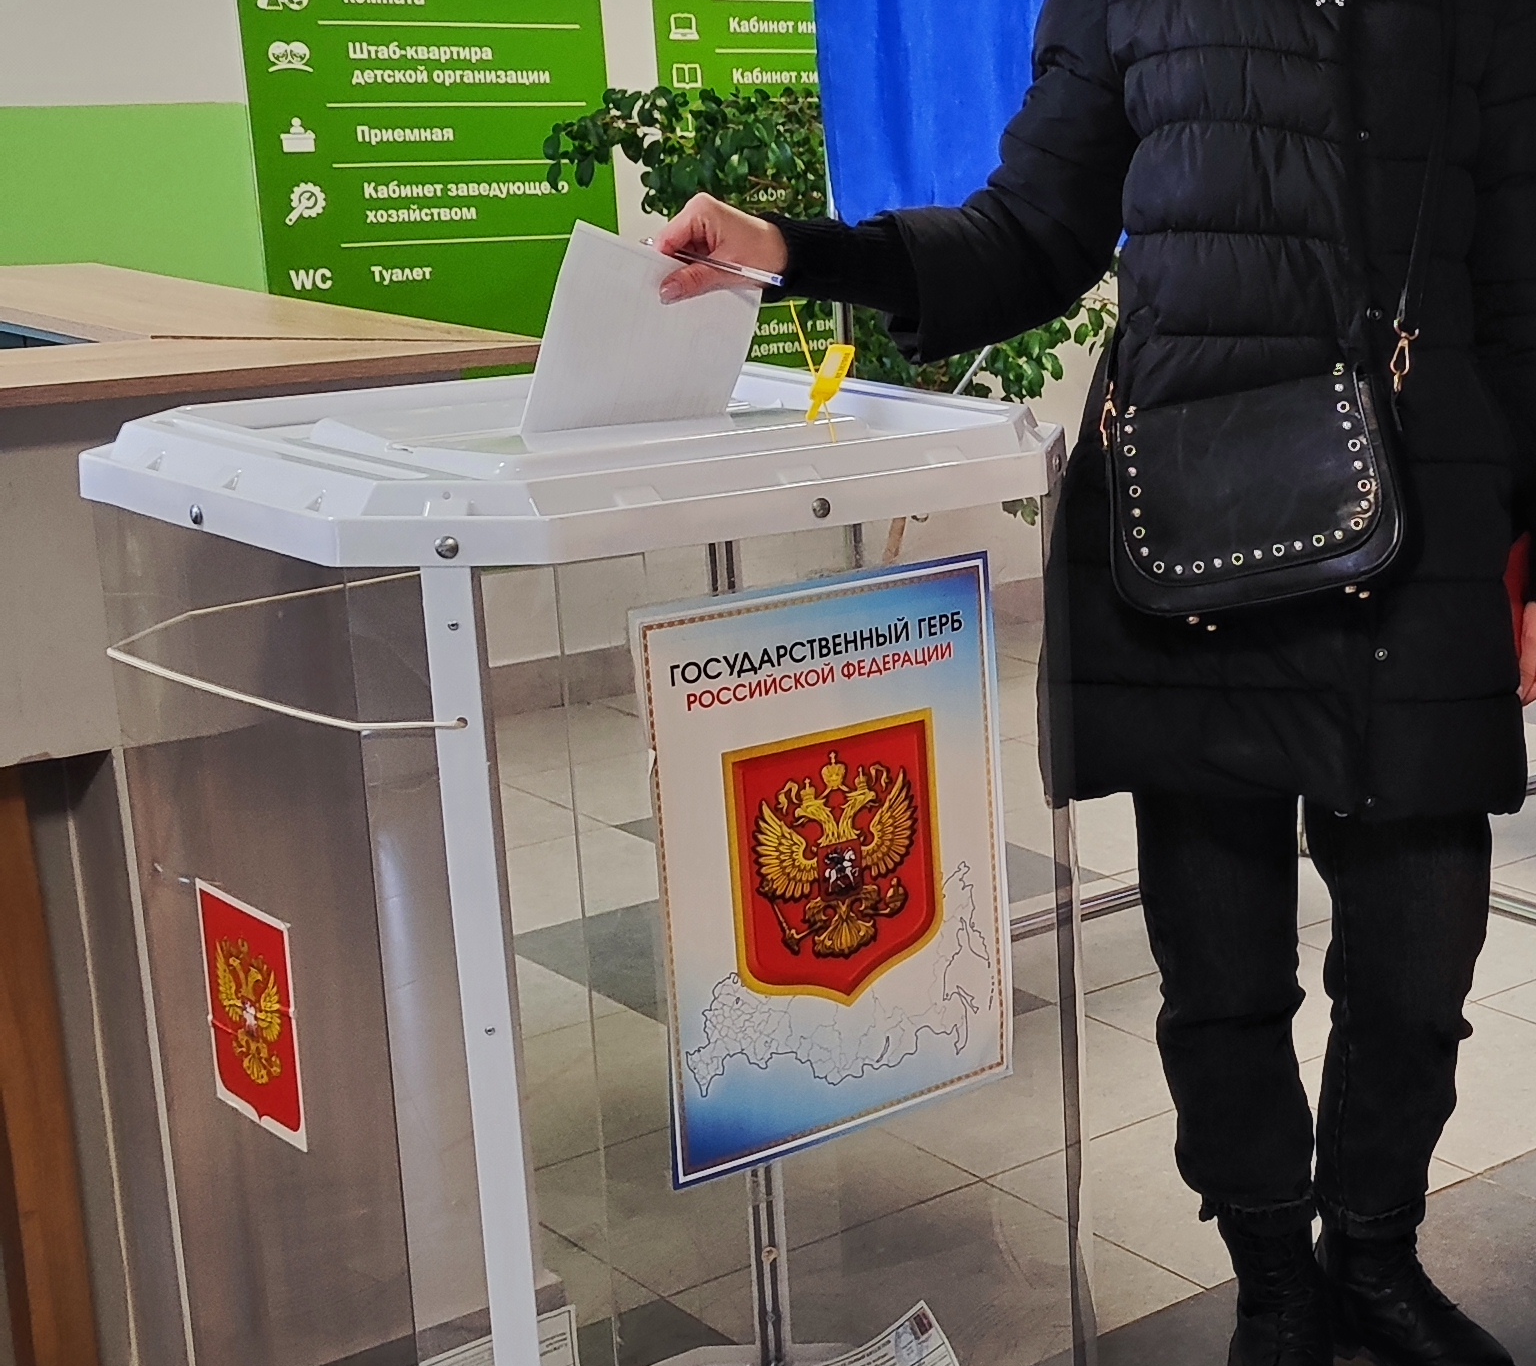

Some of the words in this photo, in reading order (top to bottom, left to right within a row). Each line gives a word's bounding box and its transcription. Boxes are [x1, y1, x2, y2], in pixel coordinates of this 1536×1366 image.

[729, 17, 794, 34] Кабинет
[348, 41, 492, 63] Штаб-квартира
[352, 66, 428, 85] детской
[433, 68, 551, 87] организации
[732, 67, 797, 84] Кабинет
[356, 126, 454, 143] Приемная
[364, 181, 443, 199] Кабинет
[447, 181, 569, 198] заведующео
[366, 204, 476, 224] хозяйством
[289, 268, 333, 291] WC
[371, 266, 432, 284] Туалет
[755, 319, 813, 337] Кабинт
[751, 337, 835, 358] деятелнос
[669, 617, 910, 686] ГОСУДАРСТВЕННЫЙ
[917, 611, 963, 639] ГЕРБ
[686, 662, 835, 711] РОССИЙСКОЙ
[840, 642, 953, 680] ФЕДЕРАЦИИ
